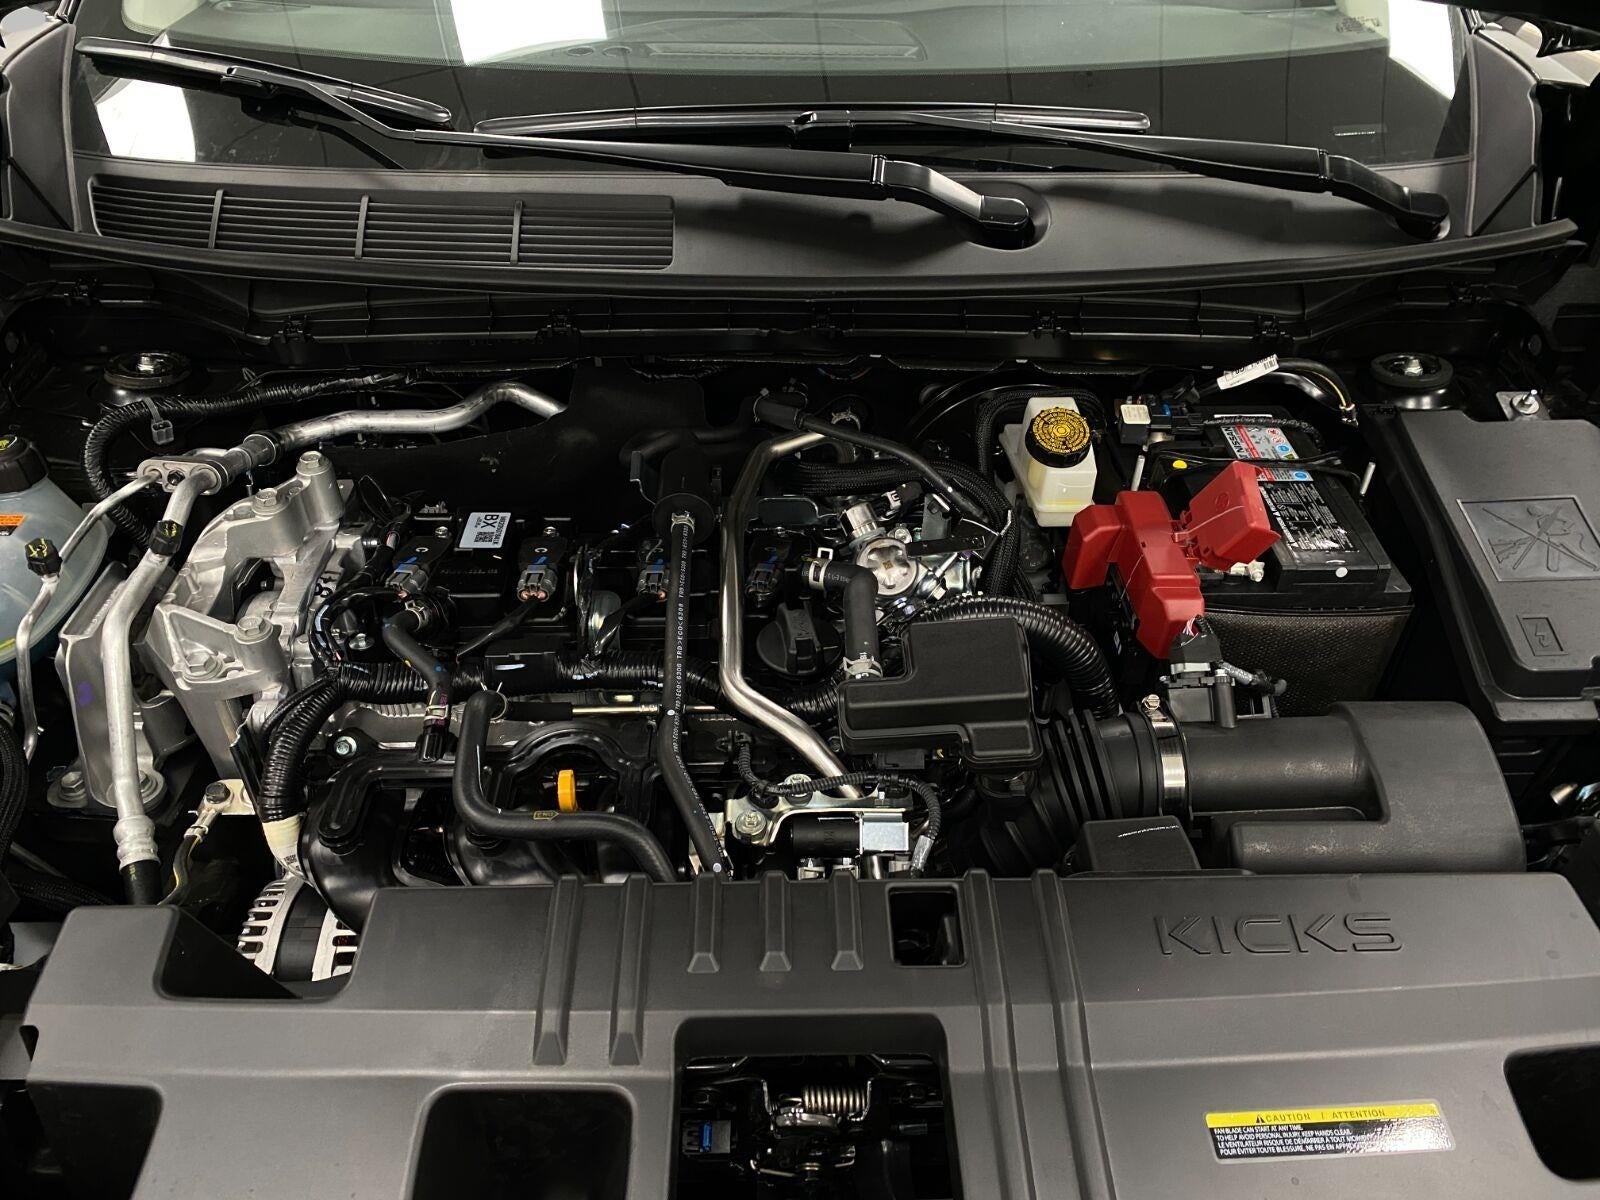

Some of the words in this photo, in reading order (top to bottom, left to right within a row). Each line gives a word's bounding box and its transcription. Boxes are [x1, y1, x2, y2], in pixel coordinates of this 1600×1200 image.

[480, 515, 499, 528] BX
[1153, 912, 1402, 954] KICKS
[1265, 1113, 1311, 1122] CAUTION
[1332, 1109, 1385, 1118] ATTENTION
[1226, 1140, 1263, 1148] VENTILATEUR
